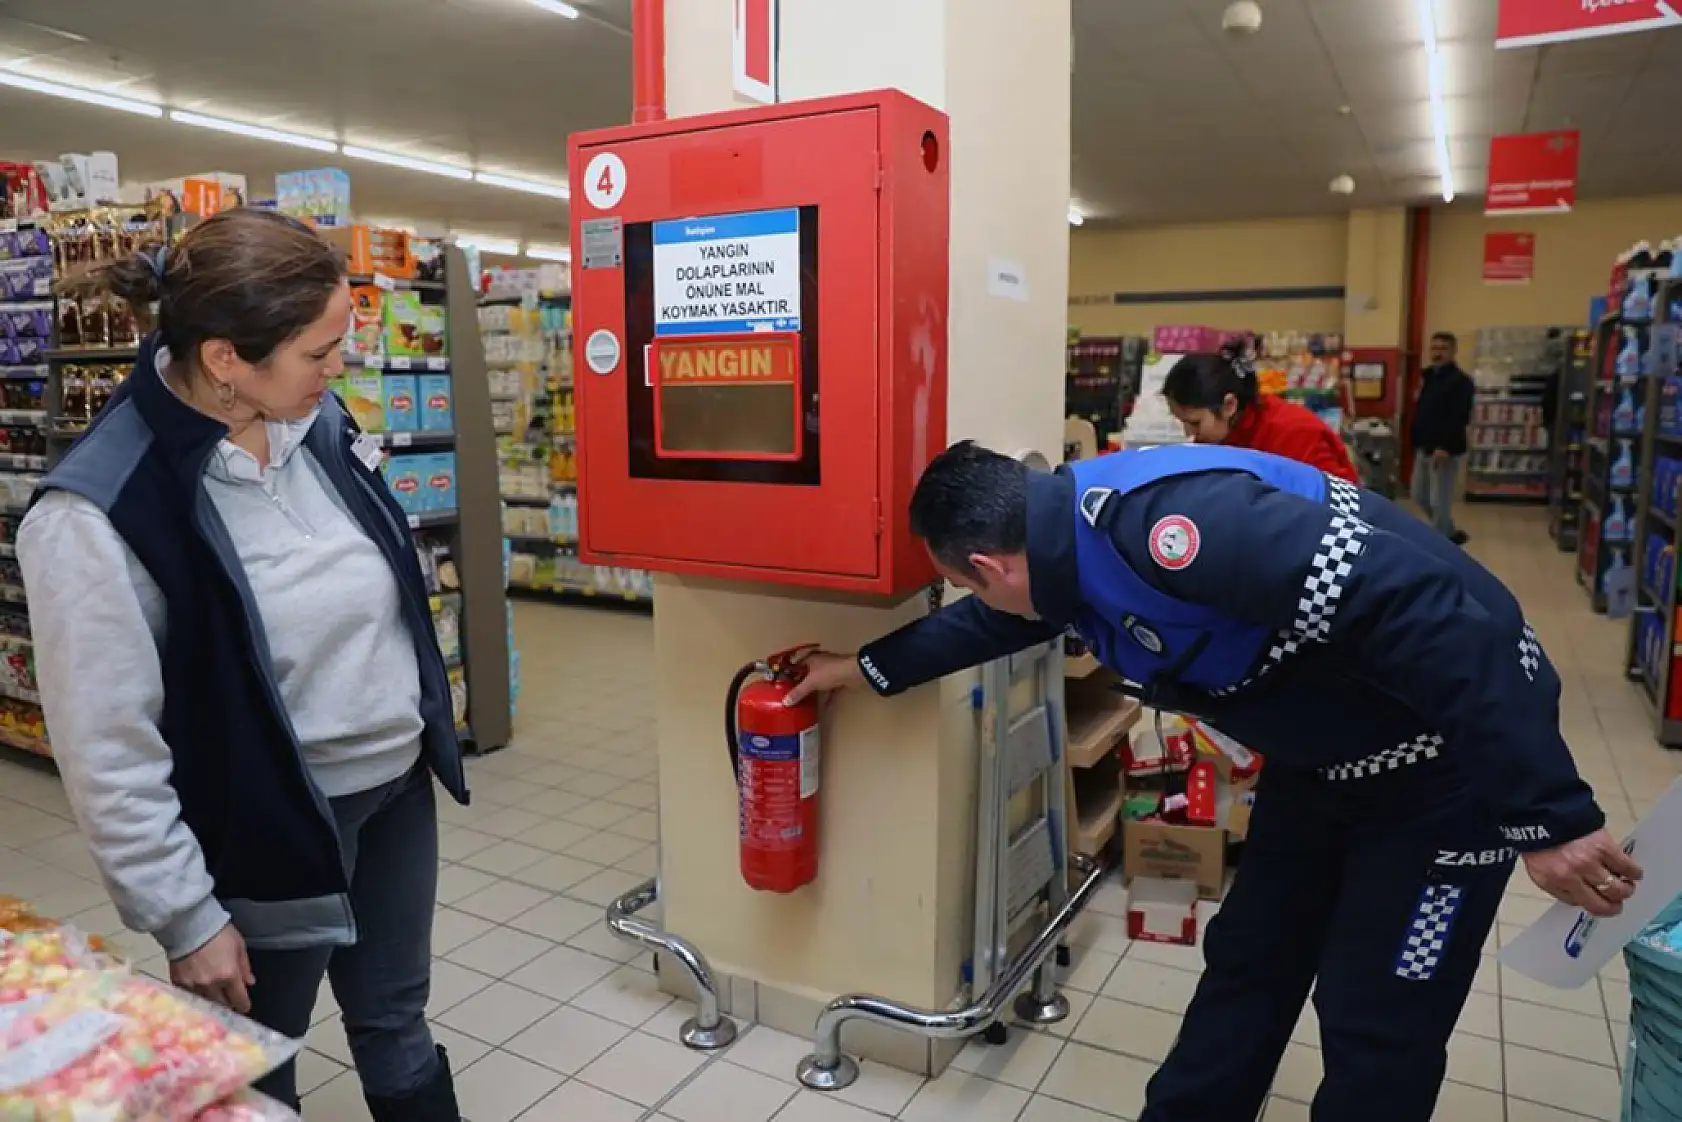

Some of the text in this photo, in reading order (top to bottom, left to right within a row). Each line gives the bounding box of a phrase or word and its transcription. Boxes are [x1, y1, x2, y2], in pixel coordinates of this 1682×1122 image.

[597, 164, 614, 196] 4
[699, 242, 749, 260] YANGIN
[676, 260, 775, 281] DOLAPLARININ
[685, 281, 765, 299] ÖNÜNE MAL
[662, 299, 792, 320] KOYMAK YASAKTIR.
[660, 347, 772, 379] YANGIN
[1499, 825, 1551, 841] ABITA
[1434, 847, 1518, 866] ZABIT
